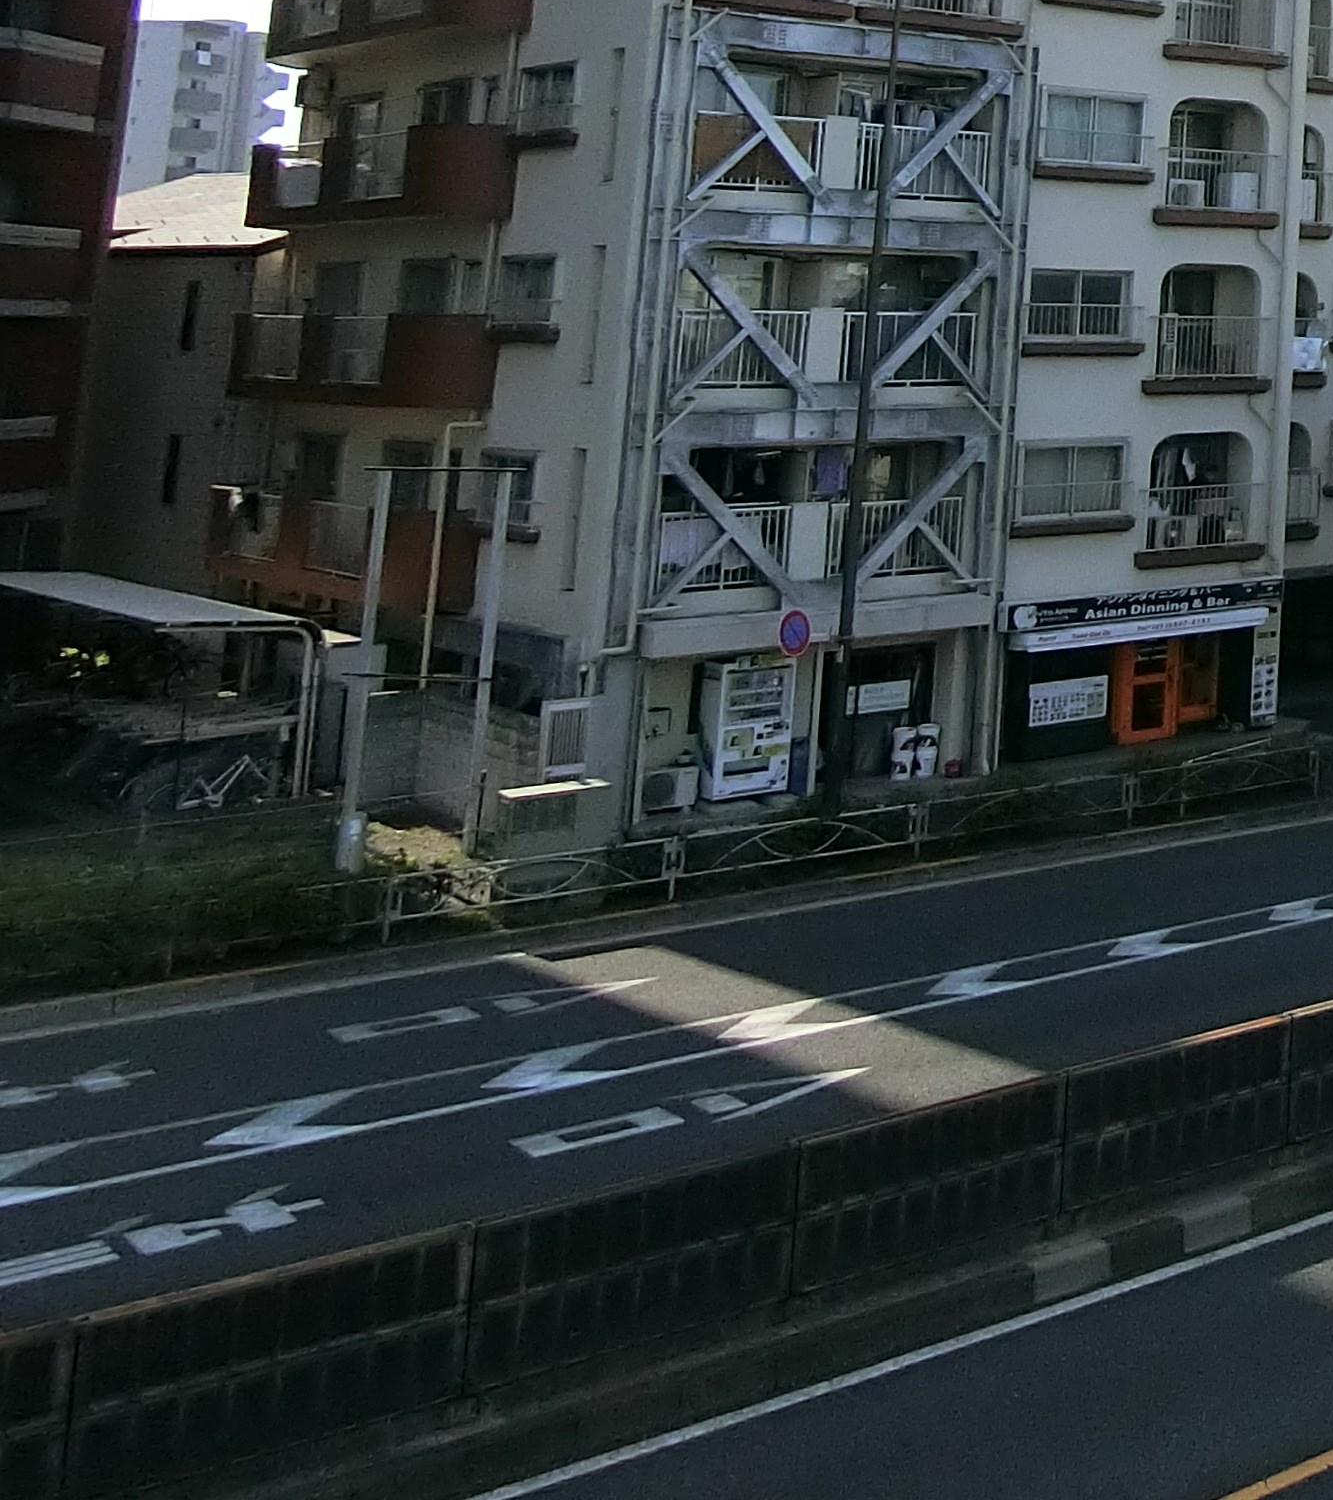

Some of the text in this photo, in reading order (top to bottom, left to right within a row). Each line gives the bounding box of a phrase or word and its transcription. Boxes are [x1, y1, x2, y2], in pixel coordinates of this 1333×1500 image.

[1084, 607, 1127, 620] Asian
[1130, 601, 1189, 618] Dinning
[1206, 596, 1231, 608] Bar
